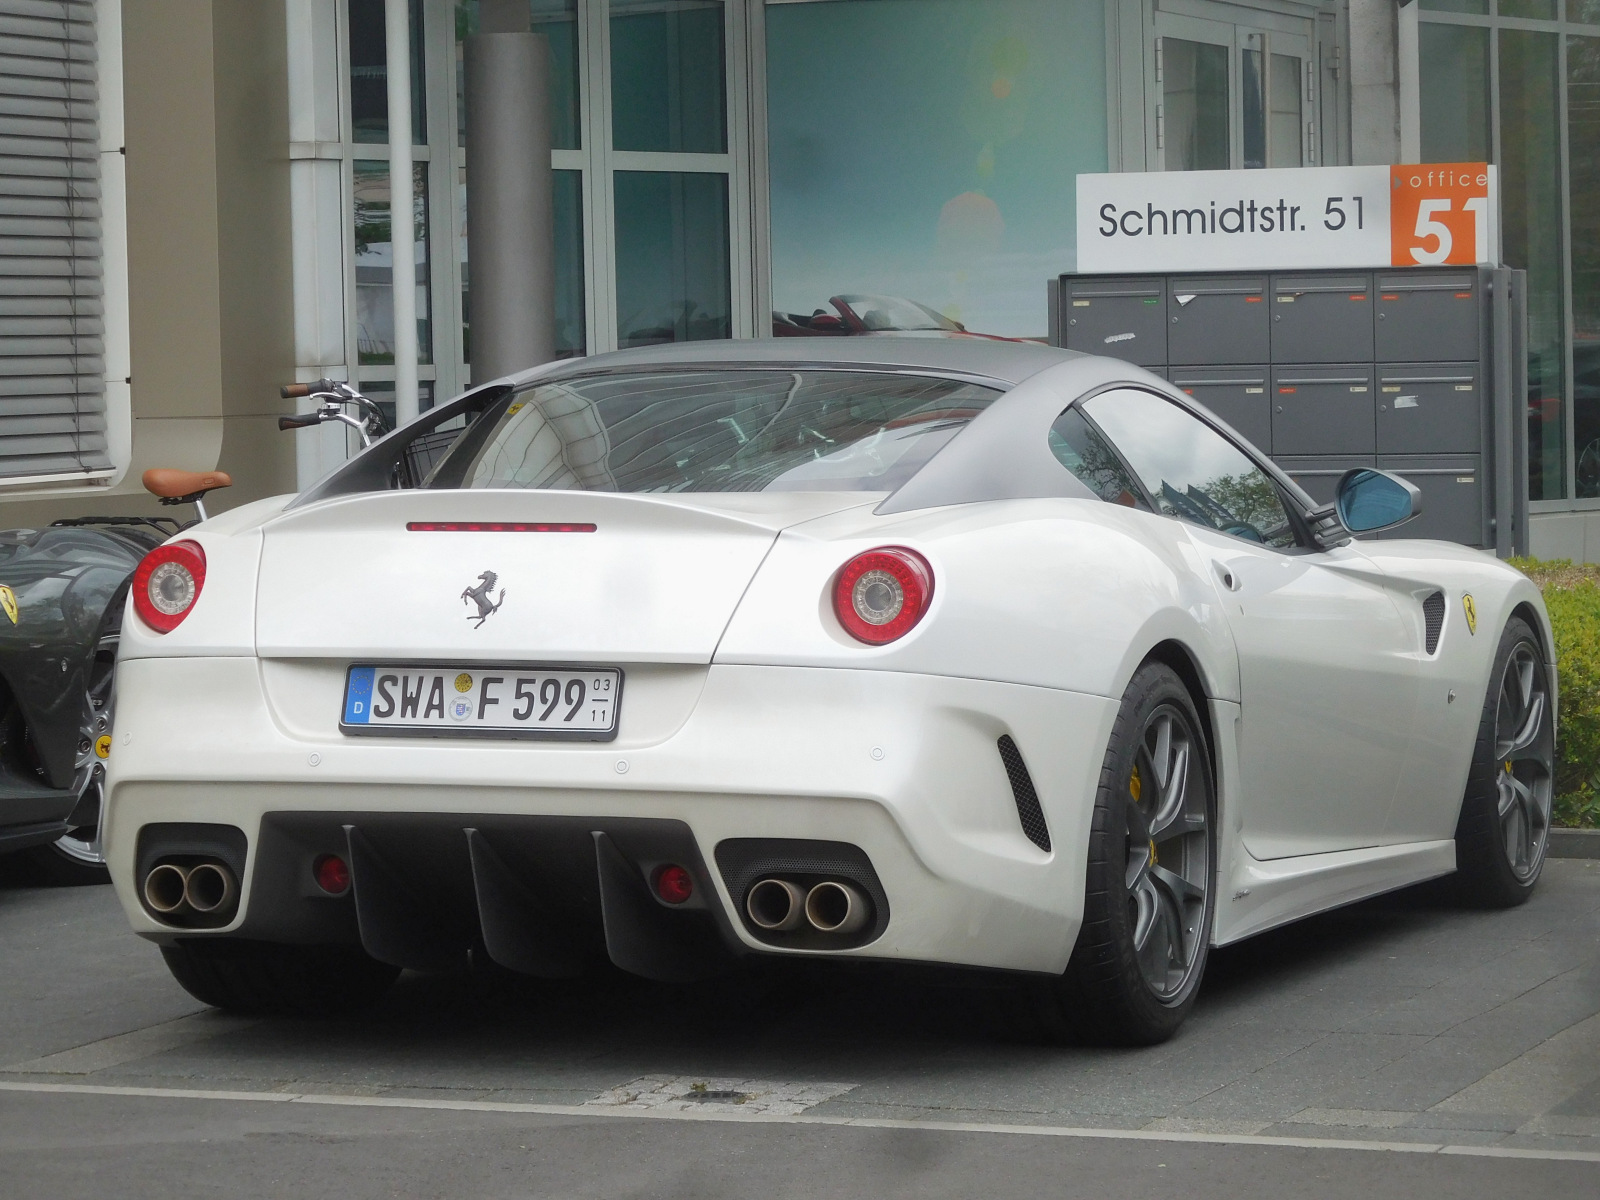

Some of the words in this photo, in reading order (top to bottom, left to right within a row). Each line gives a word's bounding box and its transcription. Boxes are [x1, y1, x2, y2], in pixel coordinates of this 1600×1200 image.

[1409, 170, 1487, 188] office
[1099, 198, 1306, 237] Schmidtstr.
[1323, 196, 1364, 231] 51
[1409, 197, 1487, 265] 51
[593, 678, 611, 691] 03
[373, 674, 445, 719] SWA
[477, 677, 504, 720] F
[512, 678, 587, 722] 599
[353, 702, 364, 714] D
[591, 709, 607, 722] 11
